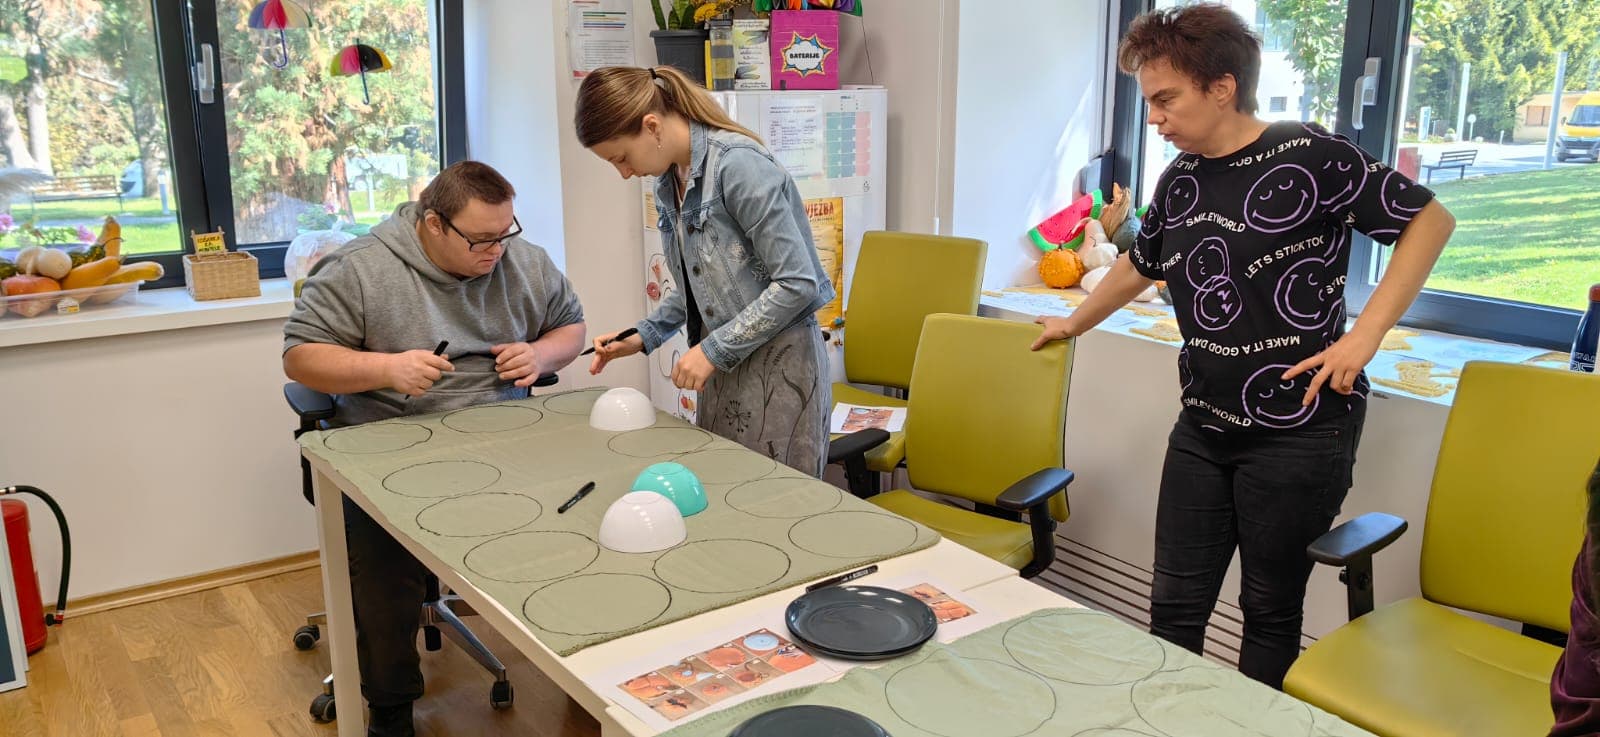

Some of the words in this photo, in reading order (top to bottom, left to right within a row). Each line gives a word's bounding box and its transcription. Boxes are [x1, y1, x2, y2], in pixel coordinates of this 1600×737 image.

[1277, 137, 1312, 151] MAKE
[1255, 152, 1264, 163] A
[1265, 148, 1275, 160] IT
[1244, 254, 1273, 279] LETS
[1275, 240, 1305, 260] STICK
[1188, 337, 1208, 349] DAY
[1253, 342, 1264, 352] IT
[1265, 335, 1300, 349] MAKE
[1208, 342, 1239, 357] GOOD
[1241, 344, 1251, 355] A
